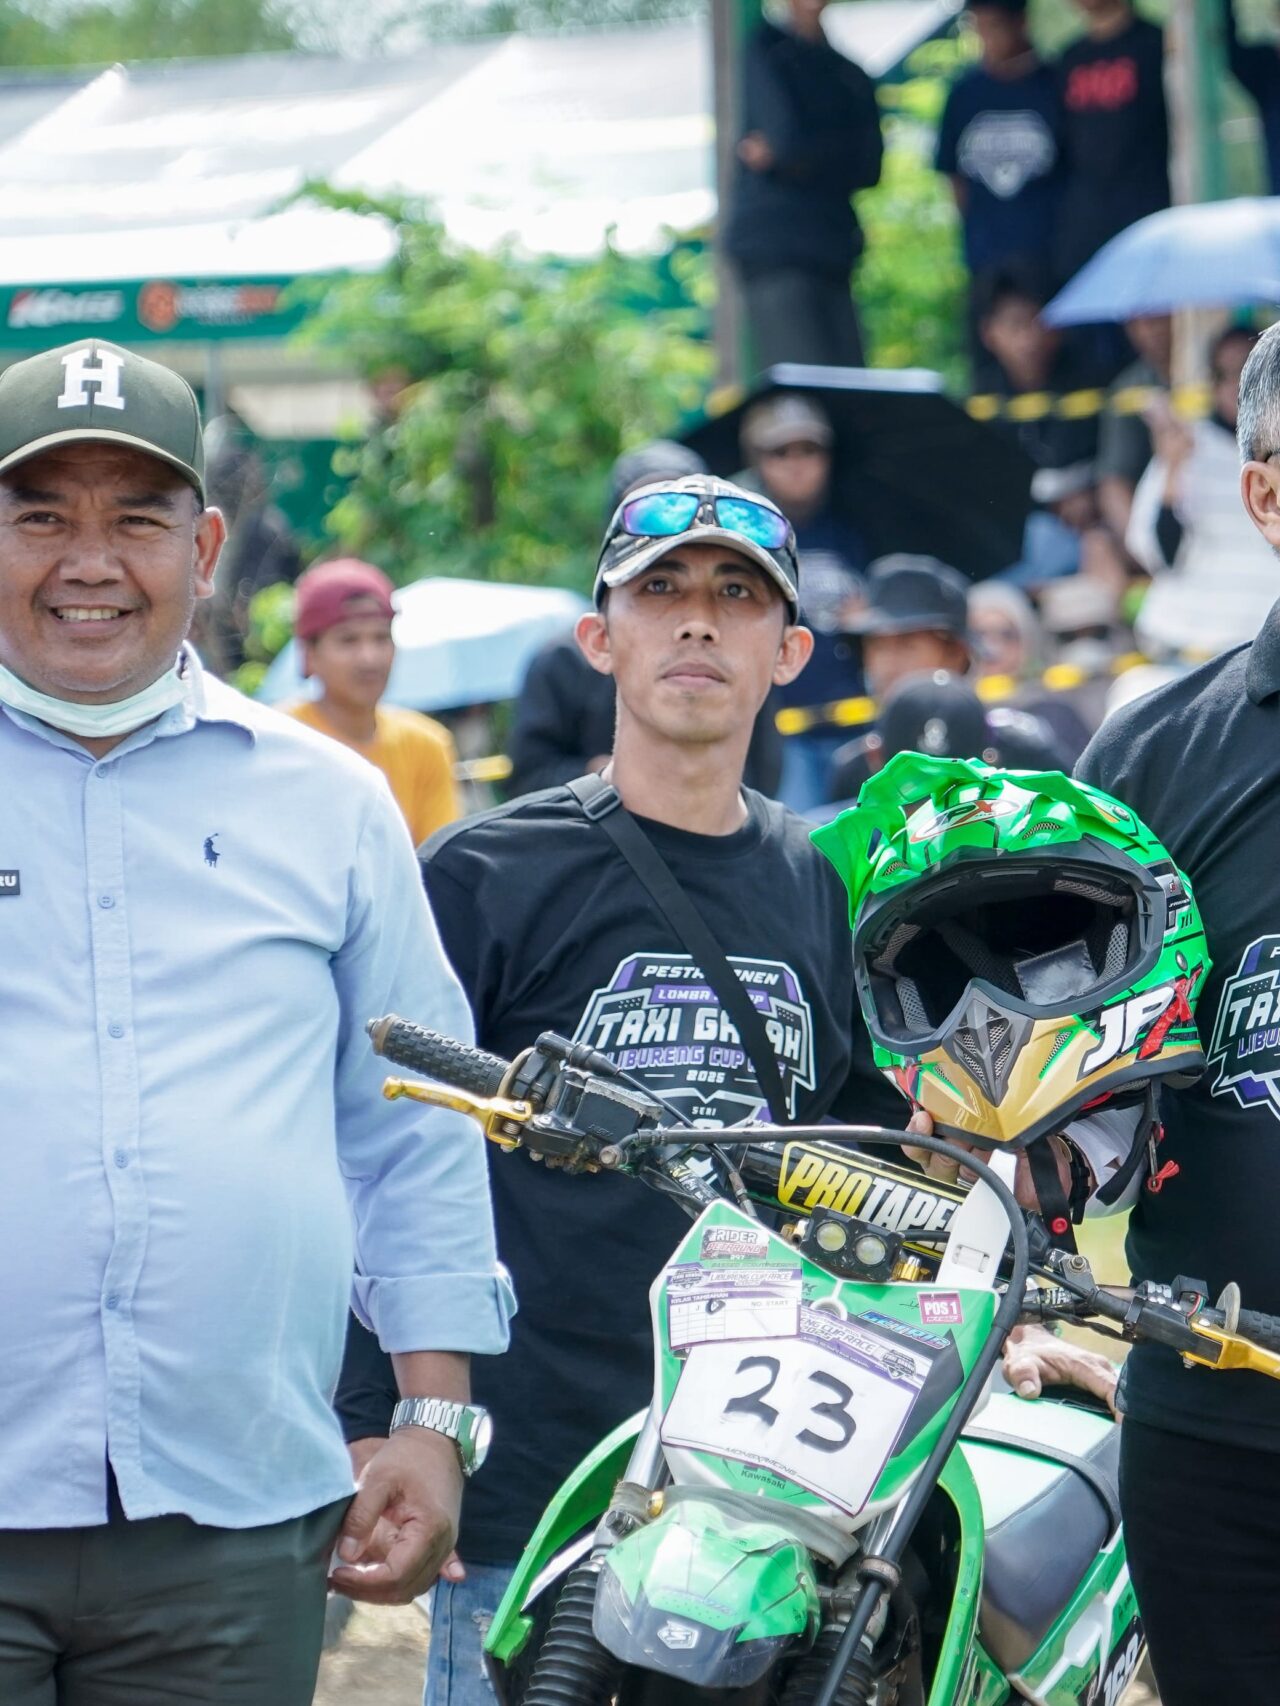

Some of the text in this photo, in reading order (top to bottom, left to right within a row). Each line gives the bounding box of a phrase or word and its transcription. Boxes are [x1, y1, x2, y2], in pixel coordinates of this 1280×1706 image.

[58, 349, 125, 410] H
[658, 988, 710, 1001] LOMBA
[595, 1007, 801, 1061] TAXI GAAH
[709, 1048, 745, 1070] CUP
[686, 1069, 726, 1083] 2025
[692, 1106, 717, 1116] SERI
[716, 1229, 758, 1244] RIDER
[924, 1301, 958, 1315] POS 1
[723, 1356, 857, 1453] 23
[741, 1469, 787, 1490] Kawasaki
